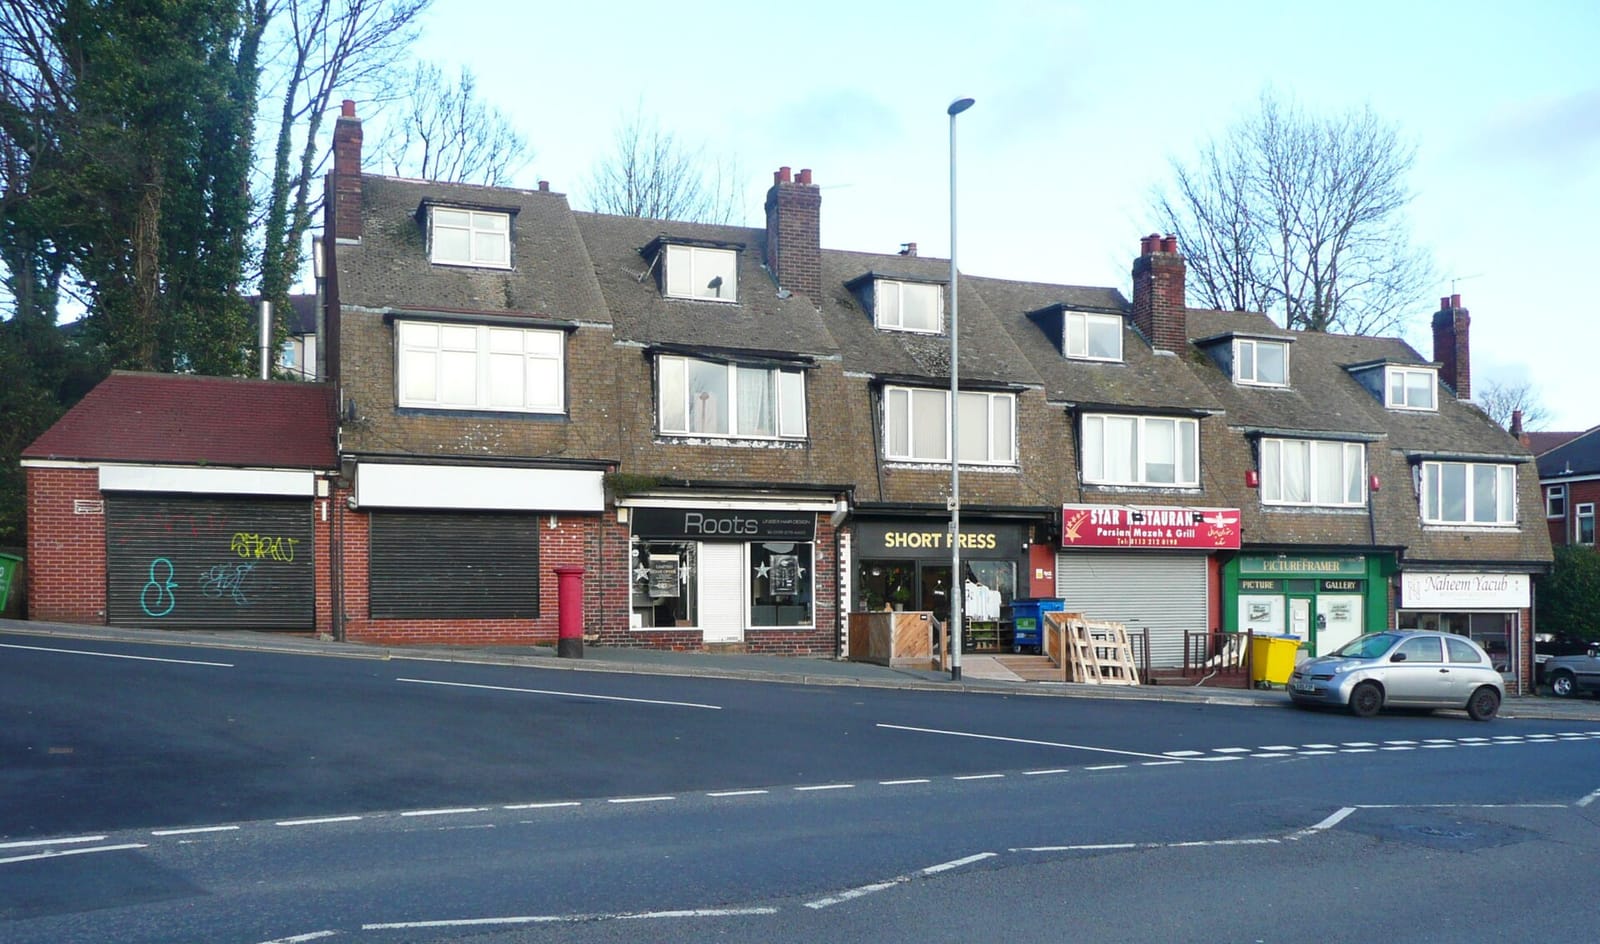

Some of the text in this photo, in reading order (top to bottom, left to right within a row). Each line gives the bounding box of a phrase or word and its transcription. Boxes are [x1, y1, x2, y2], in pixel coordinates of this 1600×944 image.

[684, 512, 759, 535] Roots
[1090, 508, 1120, 526] STAR
[884, 531, 997, 550] SHORT PRESS
[1166, 528, 1173, 539] &
[1175, 528, 1195, 540] Grill
[1263, 560, 1340, 572] PICTUREFRAMER
[1242, 580, 1275, 590] PICTURE
[1325, 581, 1357, 590] GALLERY
[1424, 574, 1471, 593] Naheem
[1473, 573, 1508, 593] Yacub
